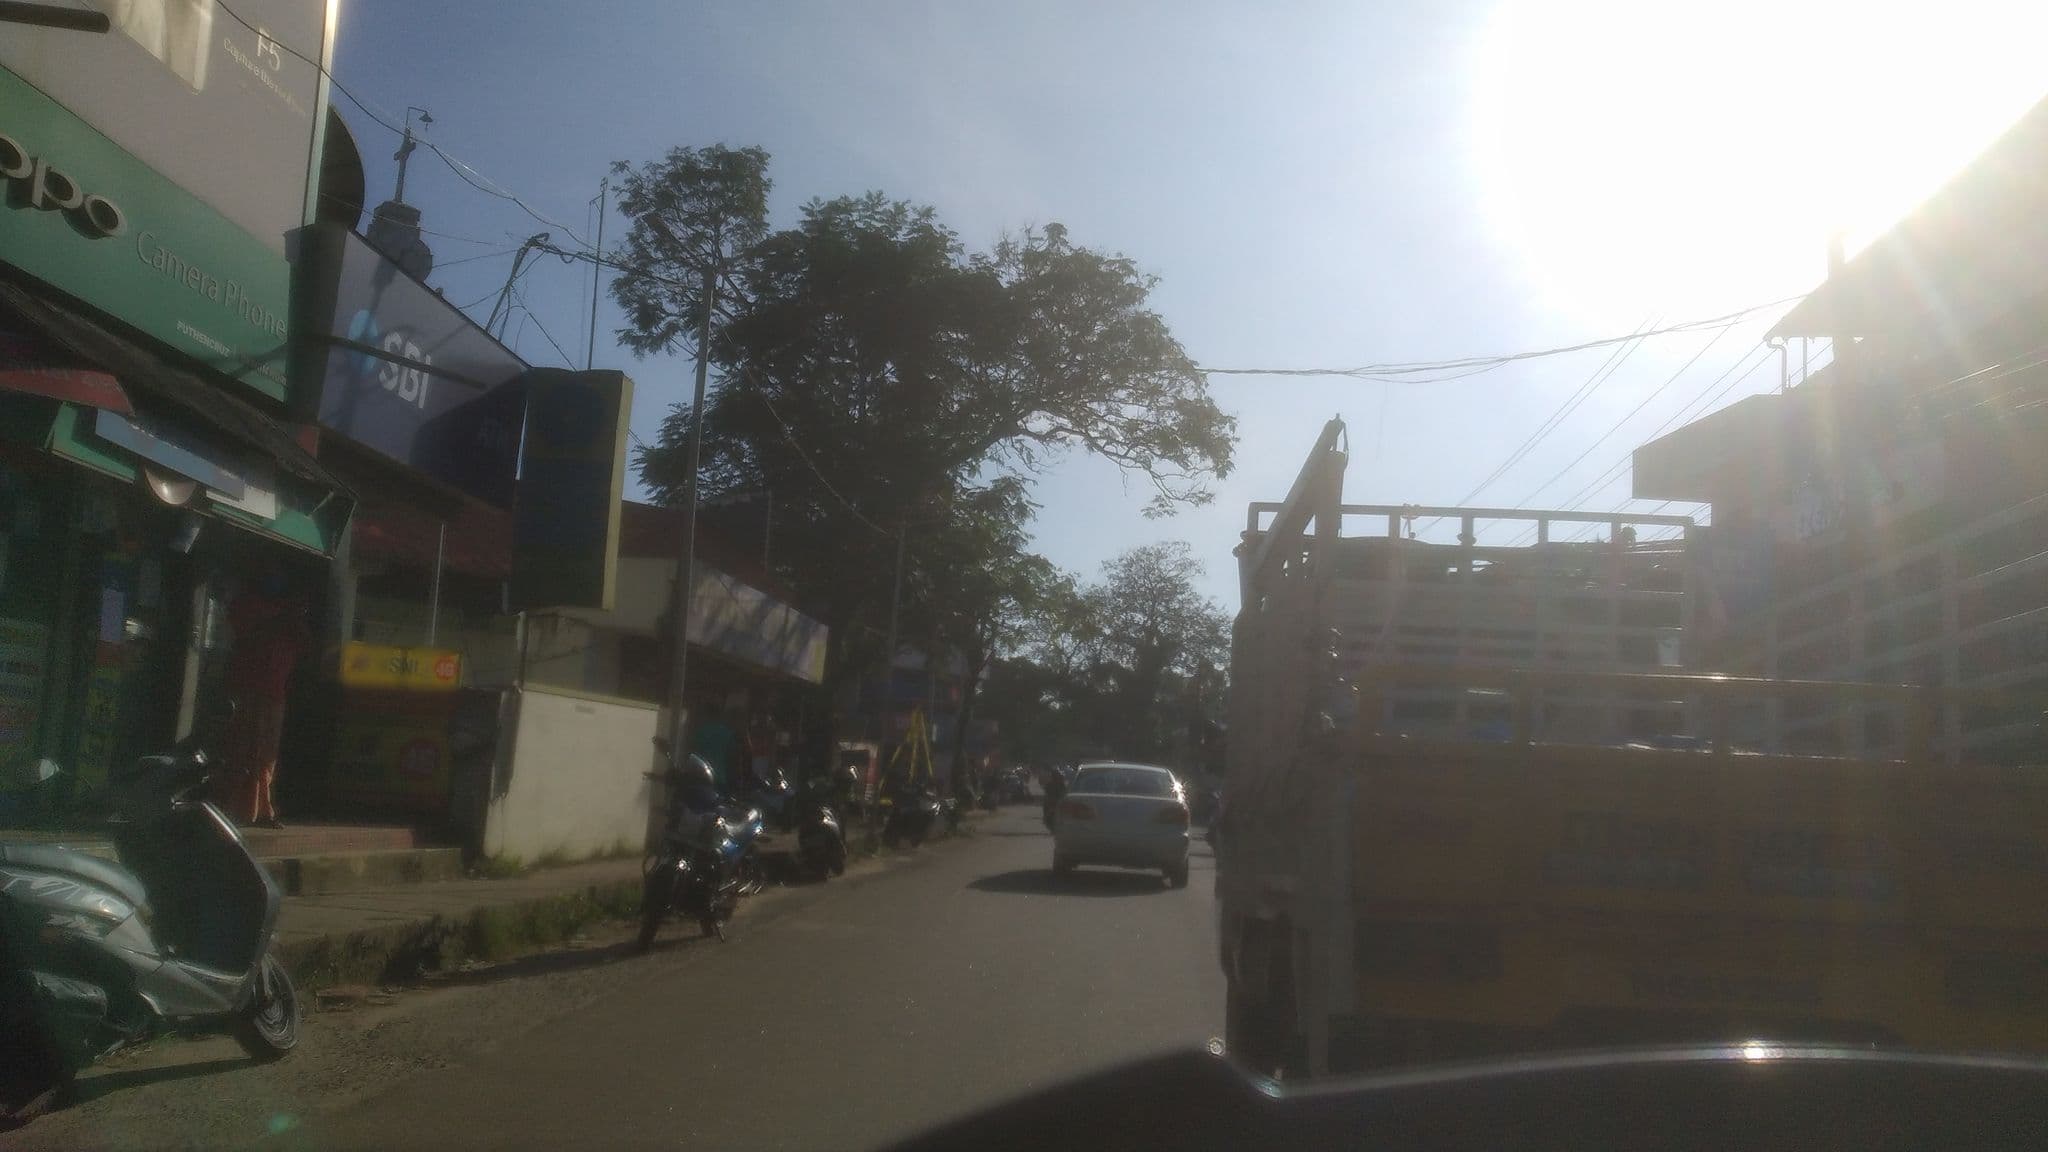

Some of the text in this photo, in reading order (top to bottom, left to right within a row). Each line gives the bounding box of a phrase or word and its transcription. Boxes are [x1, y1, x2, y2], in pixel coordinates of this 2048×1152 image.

[137, 231, 288, 343] Camera Phone
[378, 330, 433, 410] SBI
